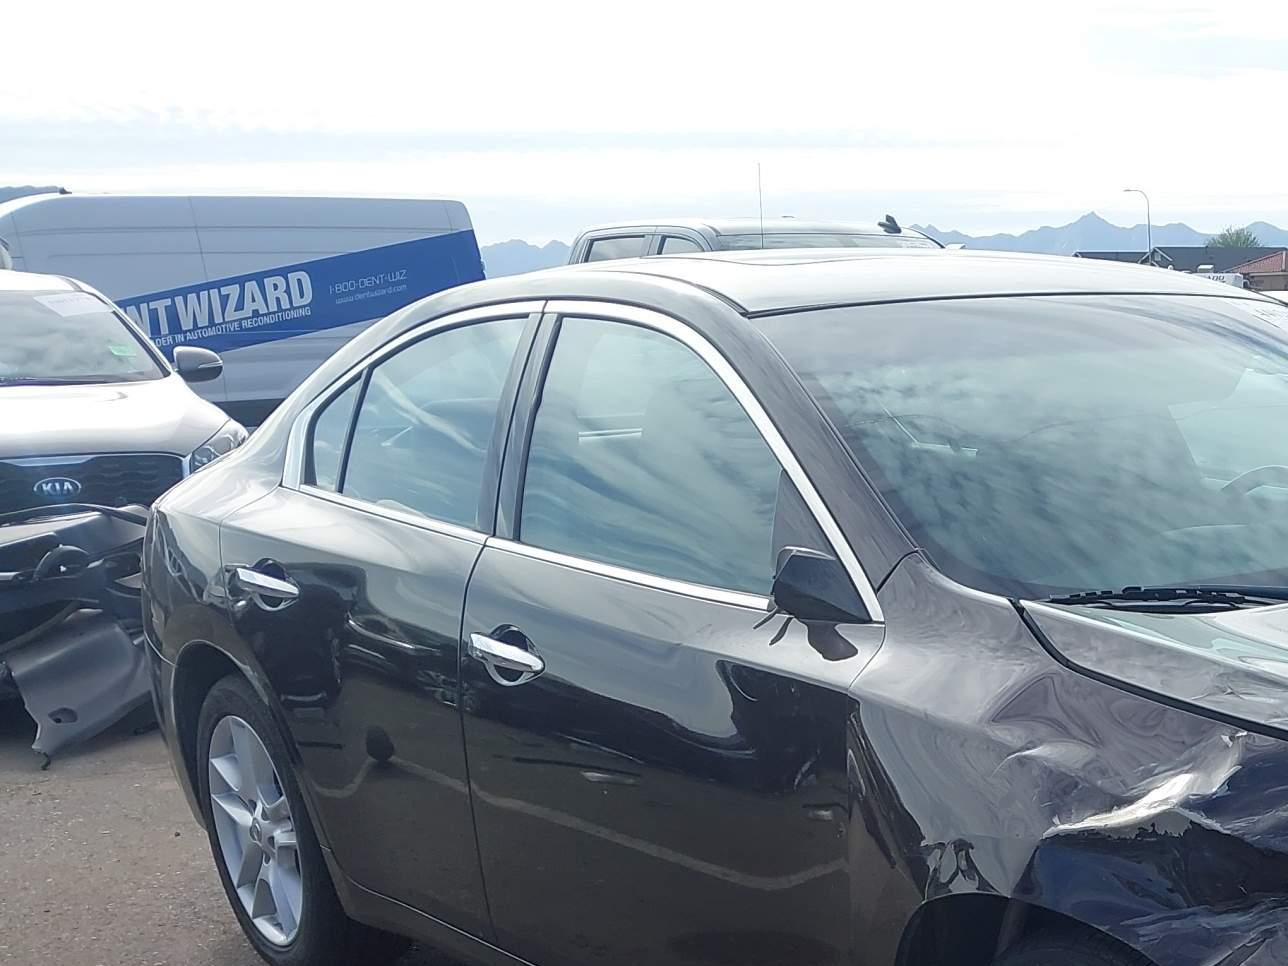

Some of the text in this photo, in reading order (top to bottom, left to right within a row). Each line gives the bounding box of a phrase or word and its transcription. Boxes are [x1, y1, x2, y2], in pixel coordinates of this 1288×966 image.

[121, 270, 313, 338] NT WIZARD
[175, 333, 185, 343] IN
[186, 322, 240, 341] AUTOMOTIVE
[242, 307, 312, 328] RECONDITIONING
[42, 482, 73, 495] KIA
